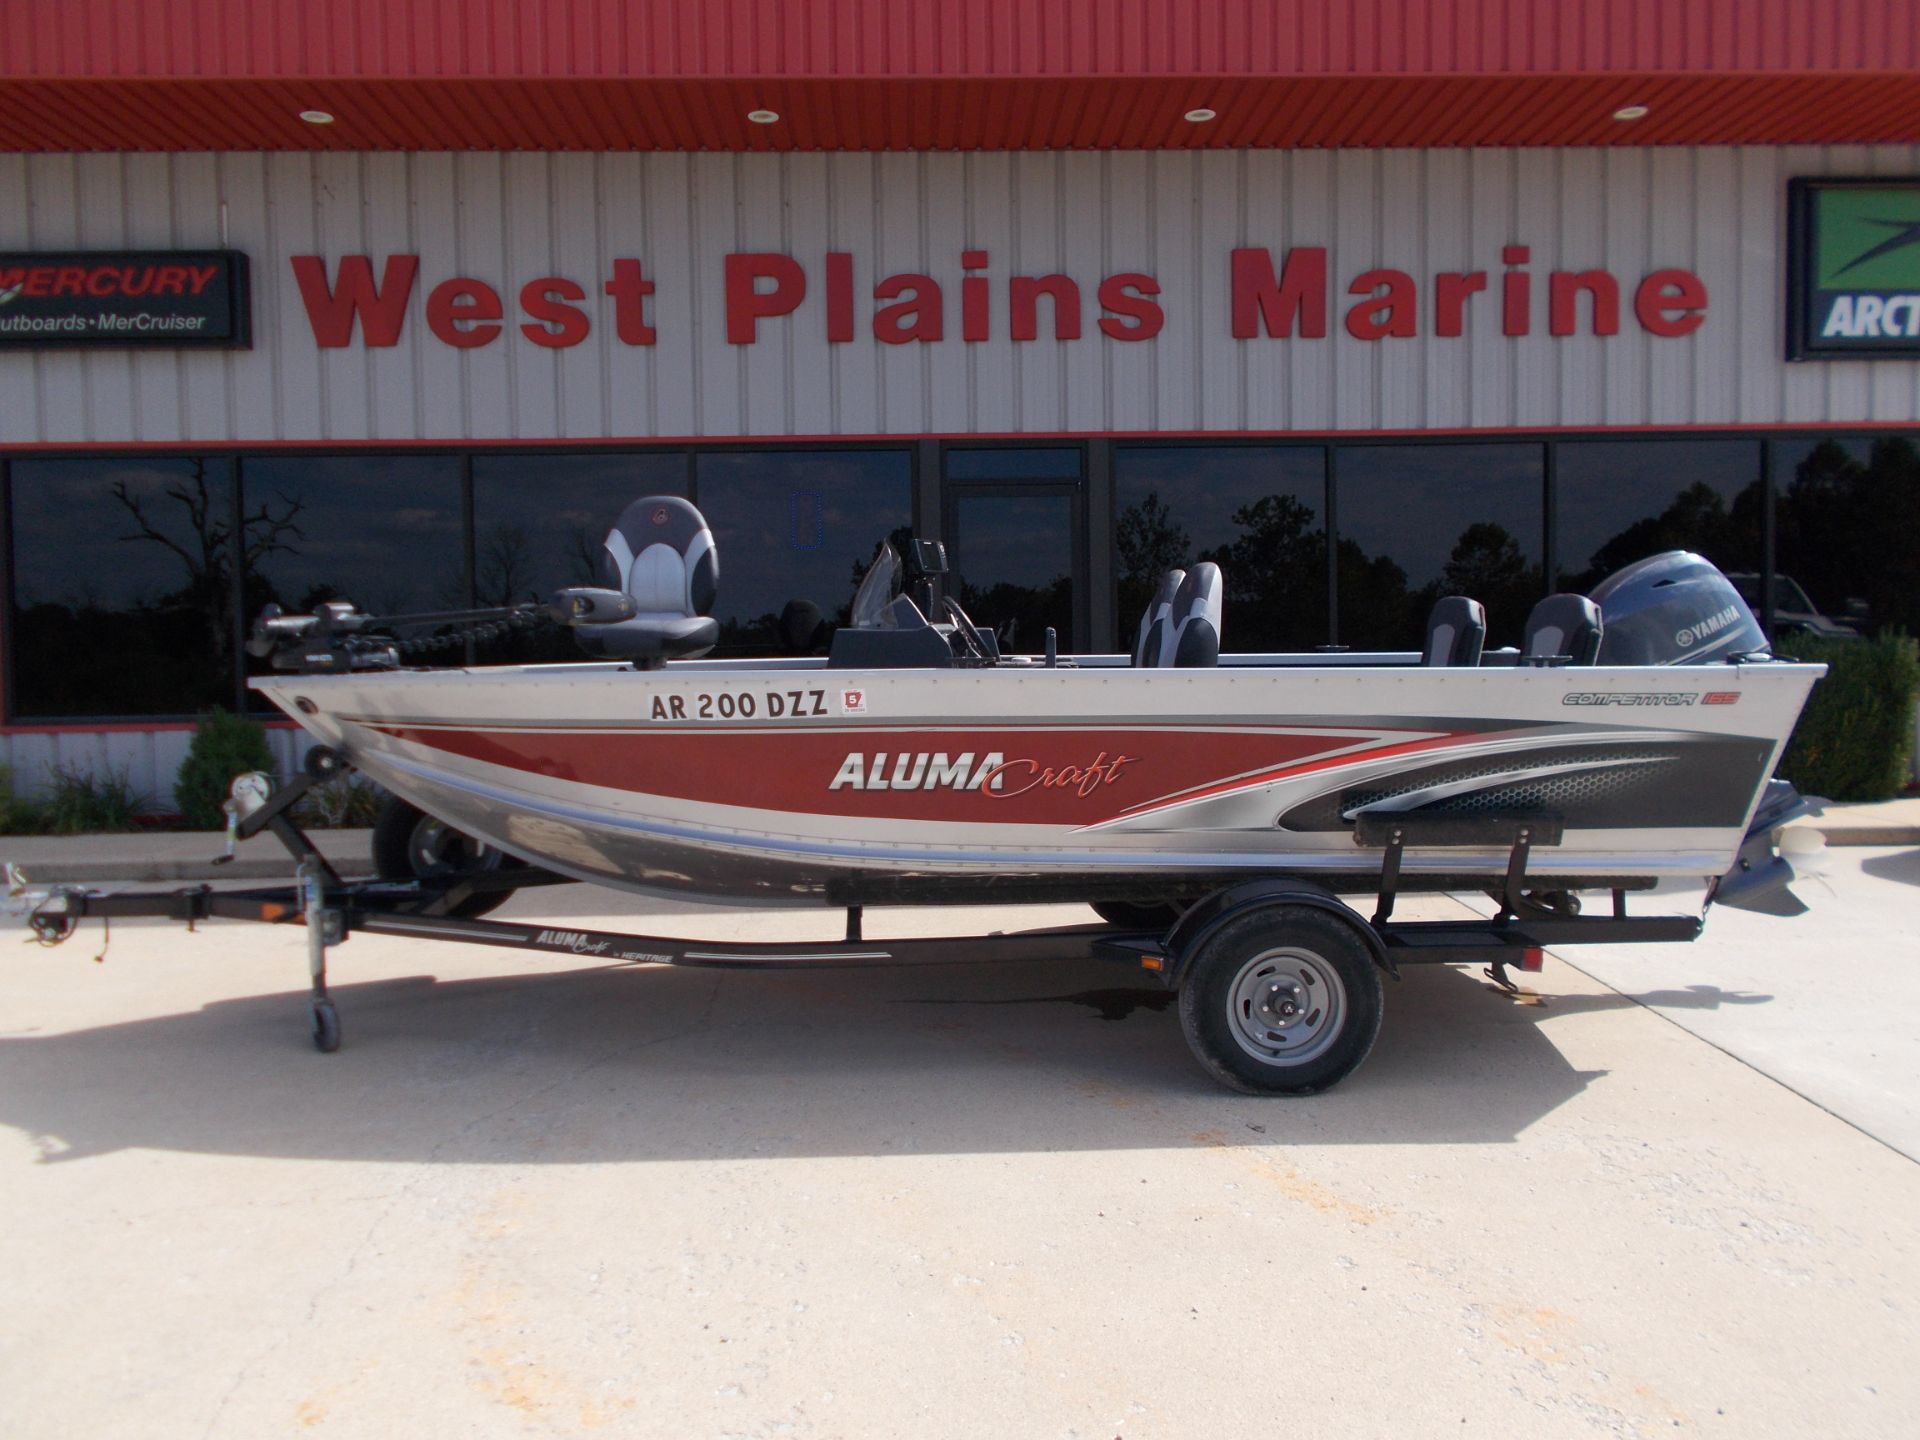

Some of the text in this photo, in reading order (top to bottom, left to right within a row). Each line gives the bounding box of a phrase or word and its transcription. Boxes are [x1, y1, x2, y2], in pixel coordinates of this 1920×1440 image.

[290, 245, 1709, 349] West Plains Marine
[1690, 604, 1740, 640] YAMAHA
[652, 690, 828, 719] AR 200 DZZ
[1561, 692, 1699, 706] COMPETITOR
[621, 951, 674, 963] HERITAGE
